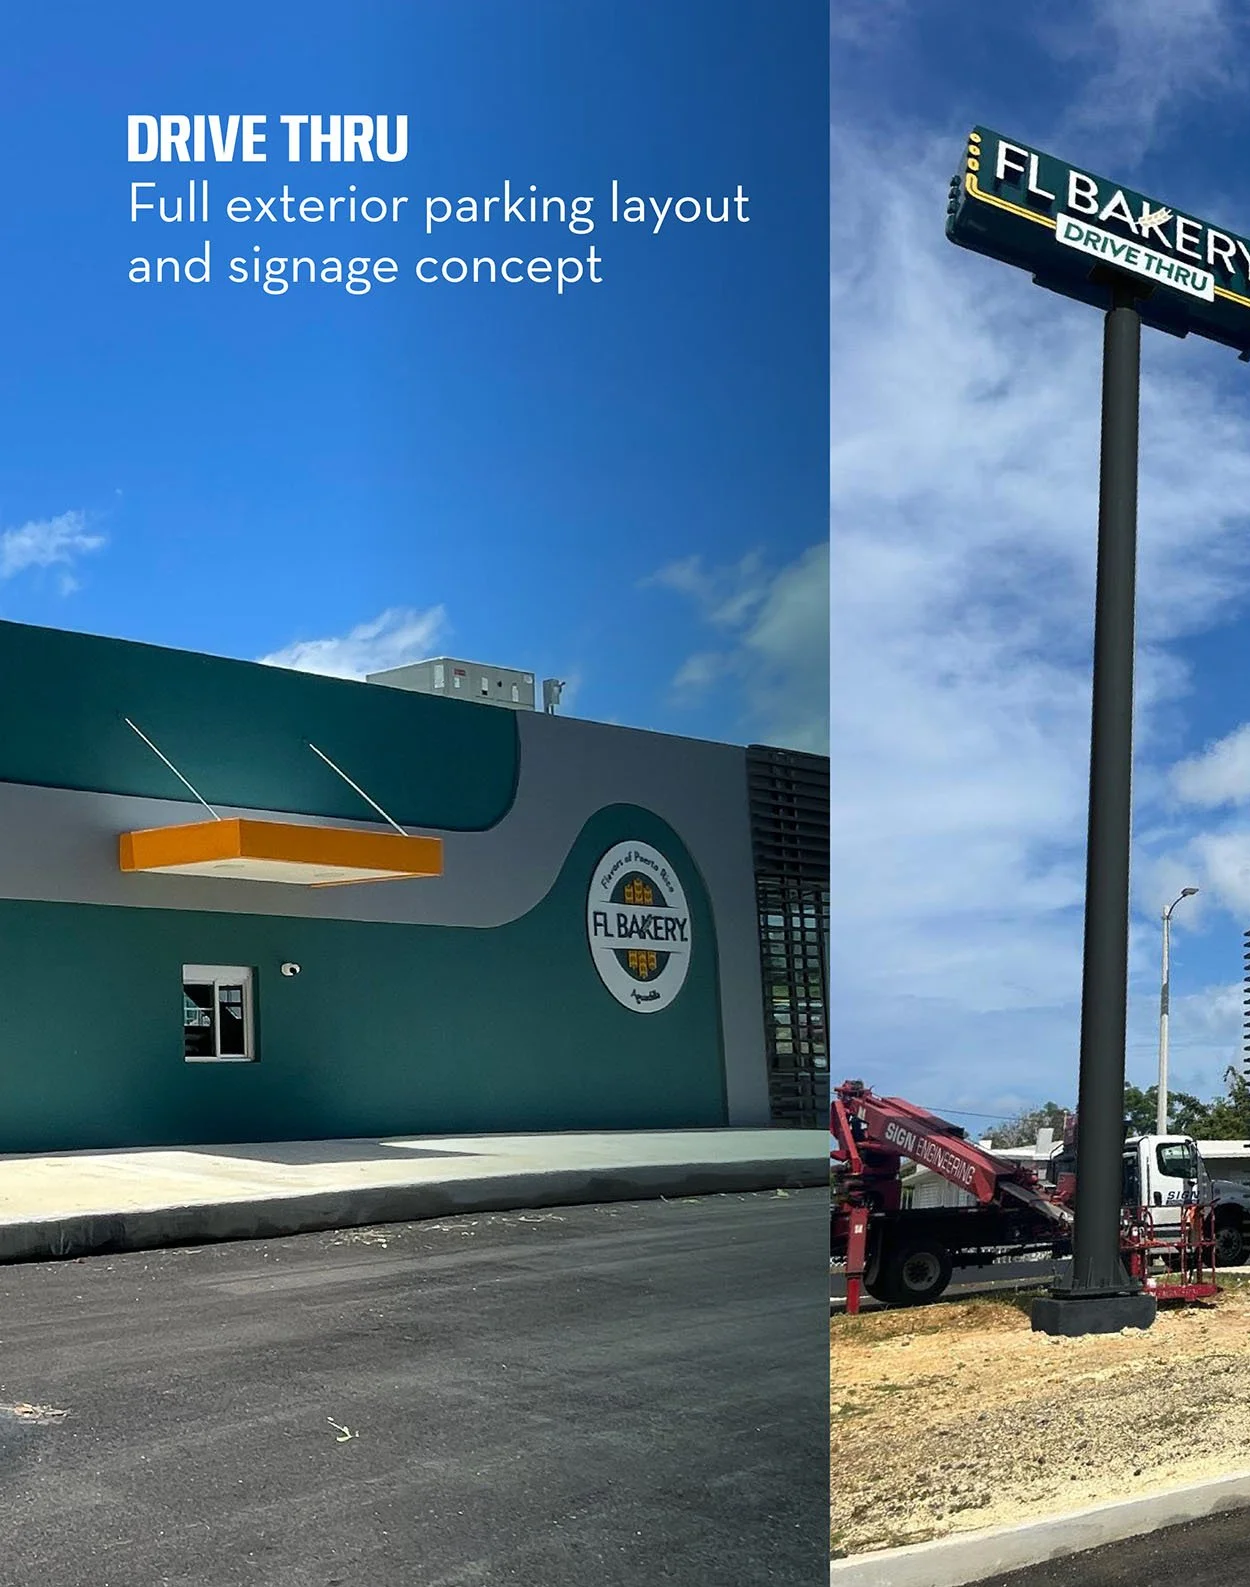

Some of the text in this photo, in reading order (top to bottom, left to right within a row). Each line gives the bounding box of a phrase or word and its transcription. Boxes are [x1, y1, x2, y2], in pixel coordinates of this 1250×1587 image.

[996, 139, 1056, 201] FL
[1063, 222, 1208, 292] DRIVE THRU
[593, 911, 688, 942] FL BAKERY
[885, 1122, 976, 1186] SIGN ENGINEERING
[1166, 1190, 1200, 1201] SIGN
